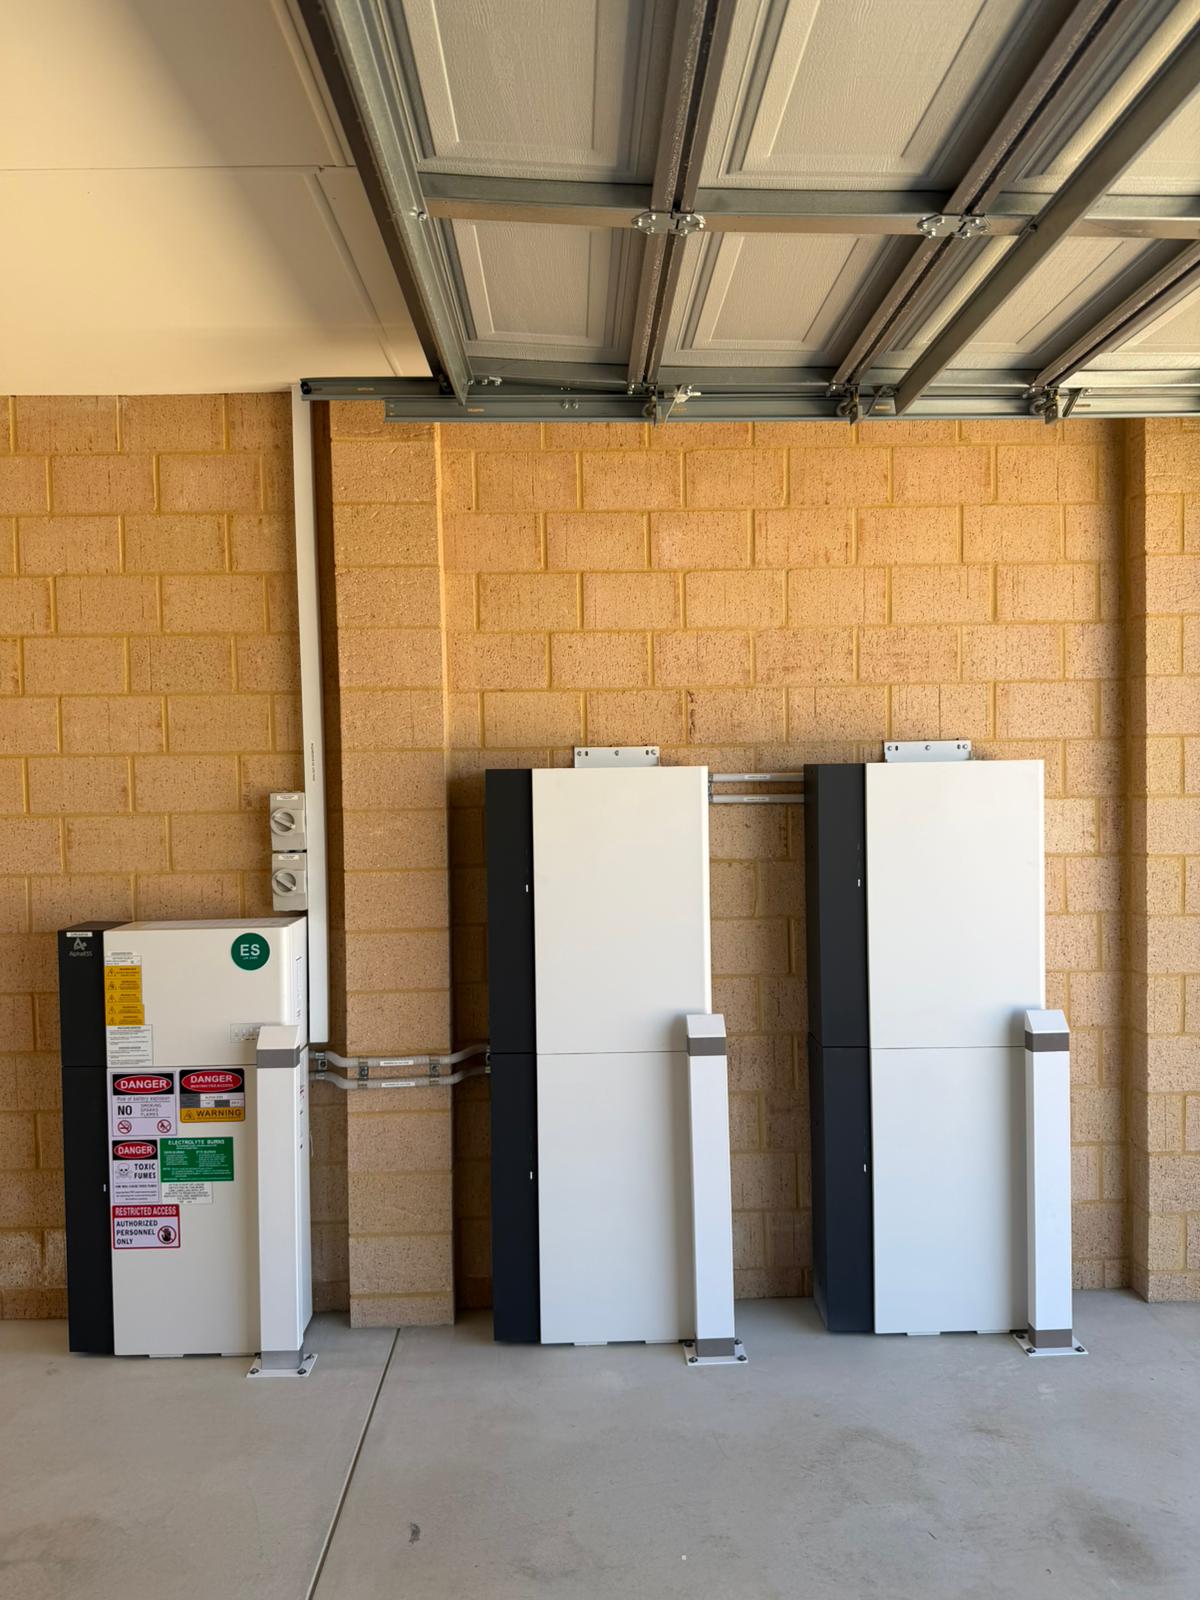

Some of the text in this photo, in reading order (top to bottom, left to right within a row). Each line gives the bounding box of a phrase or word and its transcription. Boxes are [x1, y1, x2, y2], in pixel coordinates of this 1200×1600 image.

[240, 943, 260, 956] ES
[190, 1074, 233, 1083] DANGER
[120, 1079, 167, 1089] DANGER
[117, 1105, 132, 1116] NO
[196, 1109, 242, 1117] WARNING
[118, 1145, 153, 1154] DANGER
[115, 1206, 176, 1216] RESTRICTED ACCESS
